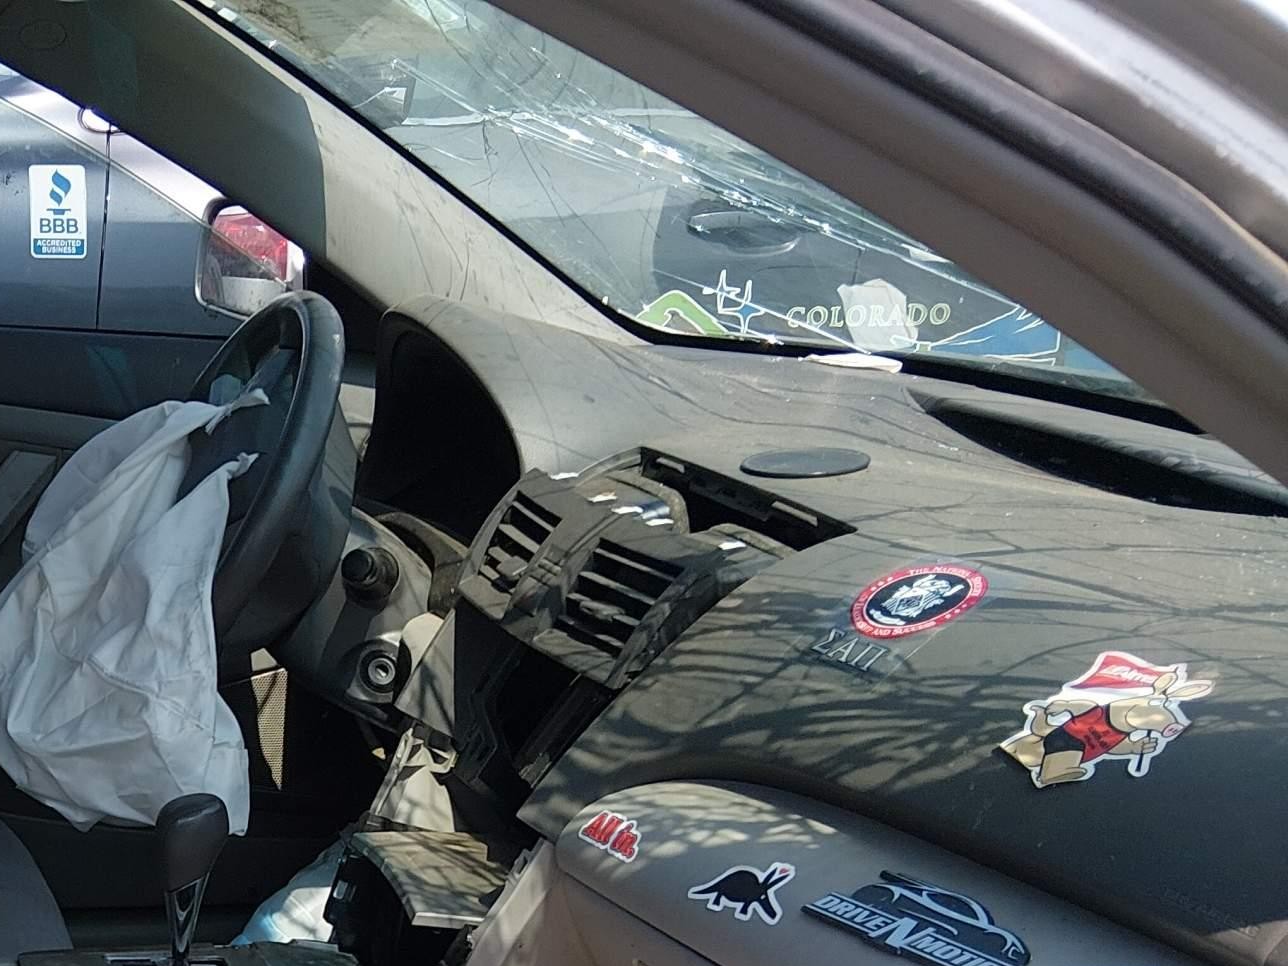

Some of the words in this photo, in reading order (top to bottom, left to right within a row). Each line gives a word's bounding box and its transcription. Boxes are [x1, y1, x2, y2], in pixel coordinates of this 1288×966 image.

[39, 218, 79, 233] BBB
[36, 239, 82, 247] ACCREDITED
[41, 246, 77, 254] BUSINESS
[786, 302, 952, 328] COLORADO
